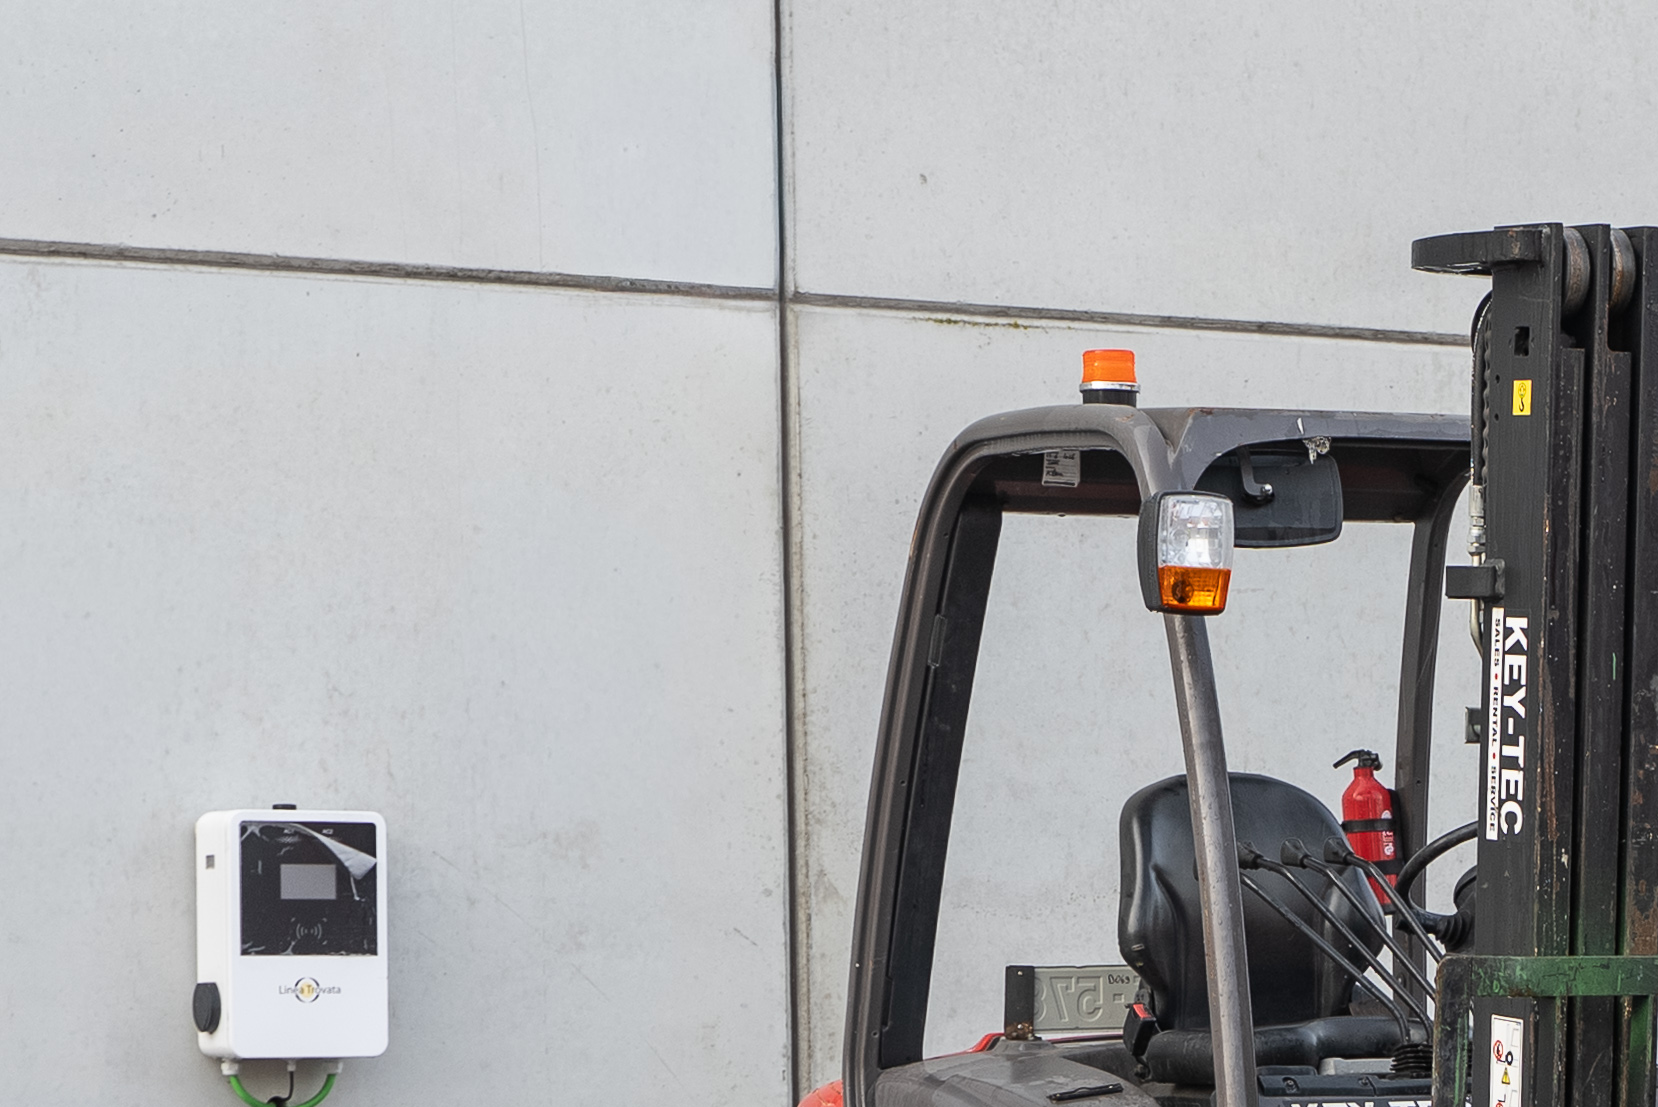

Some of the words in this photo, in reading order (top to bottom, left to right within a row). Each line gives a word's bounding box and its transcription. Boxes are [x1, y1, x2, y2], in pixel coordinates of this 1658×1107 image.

[1493, 617, 1501, 667] SALES
[1491, 686, 1500, 748] RENTAL
[1500, 616, 1528, 835] KEY-TEC
[1488, 765, 1497, 833] SERVICE
